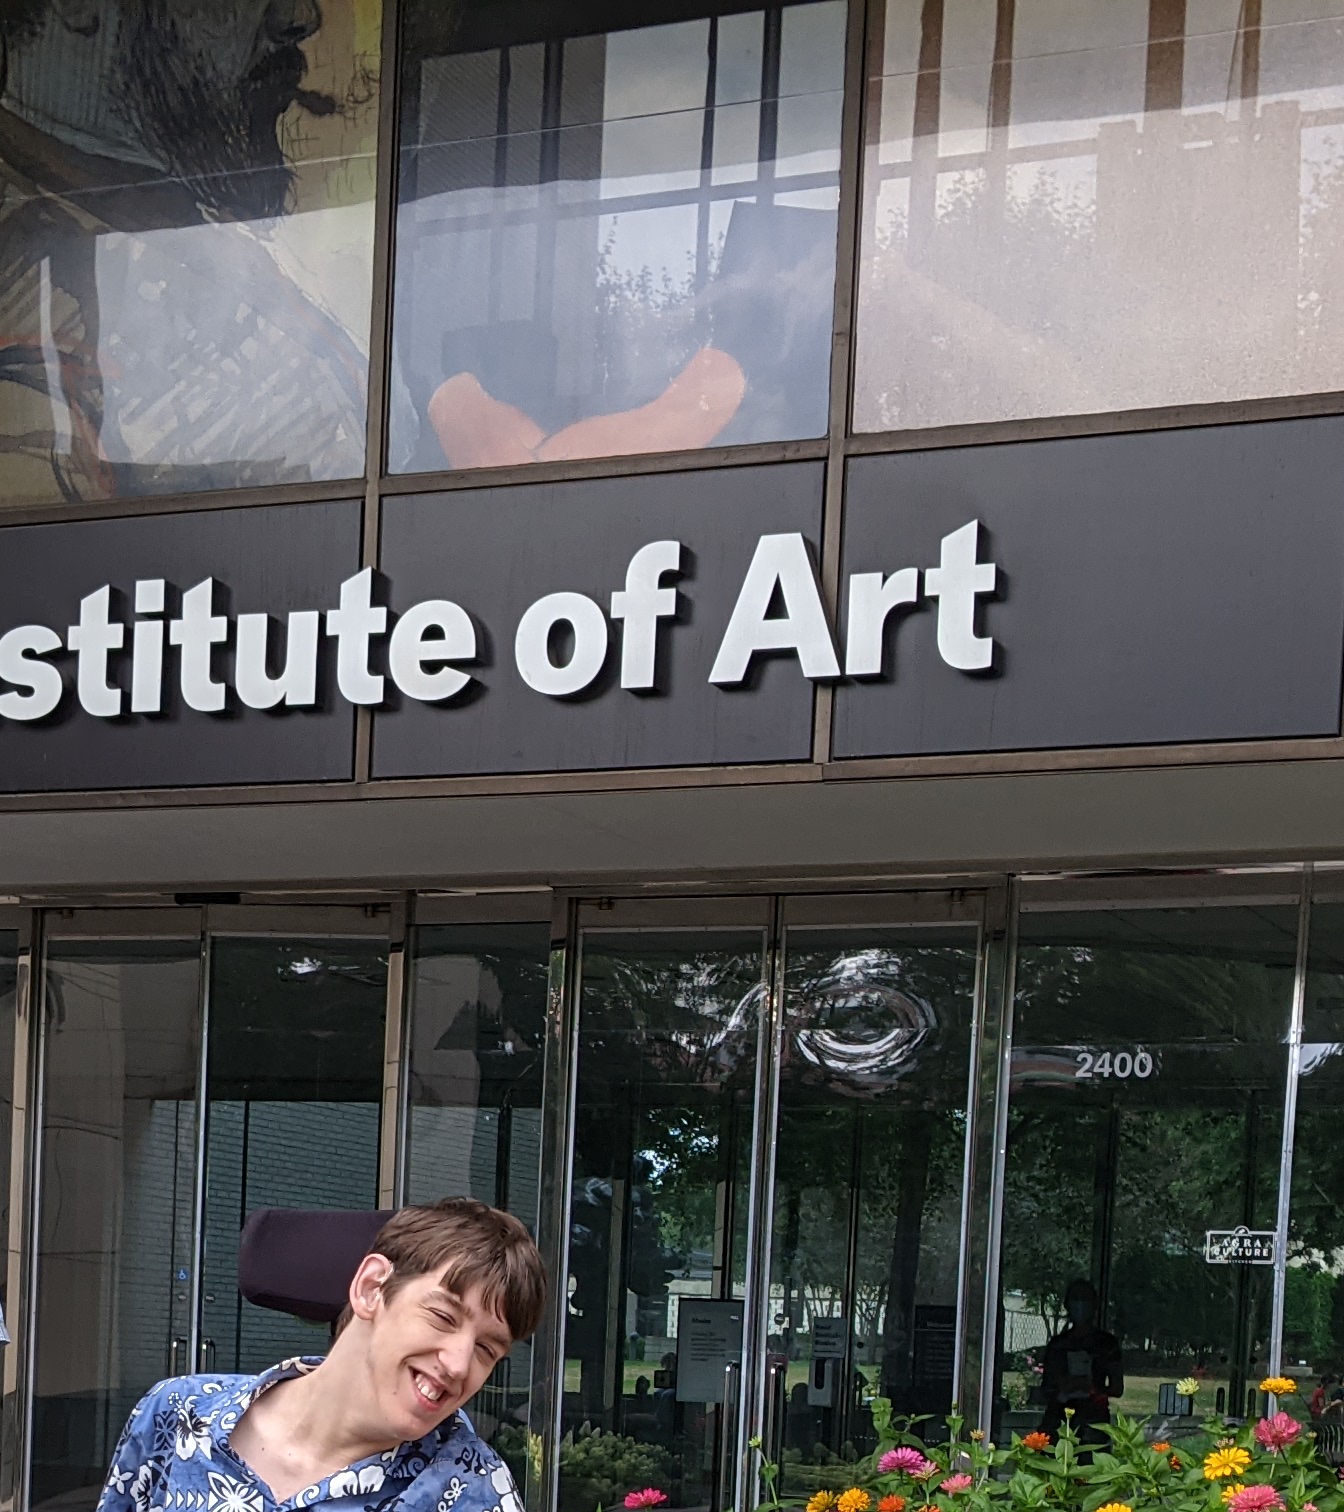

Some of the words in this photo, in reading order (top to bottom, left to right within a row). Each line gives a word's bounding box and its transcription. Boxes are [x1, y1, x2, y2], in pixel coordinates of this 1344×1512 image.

[514, 539, 683, 697] of
[707, 518, 997, 686] Art
[1075, 1051, 1153, 1078] 2400
[1221, 1238, 1262, 1248] AGRA
[1213, 1248, 1269, 1257] CULTURE
